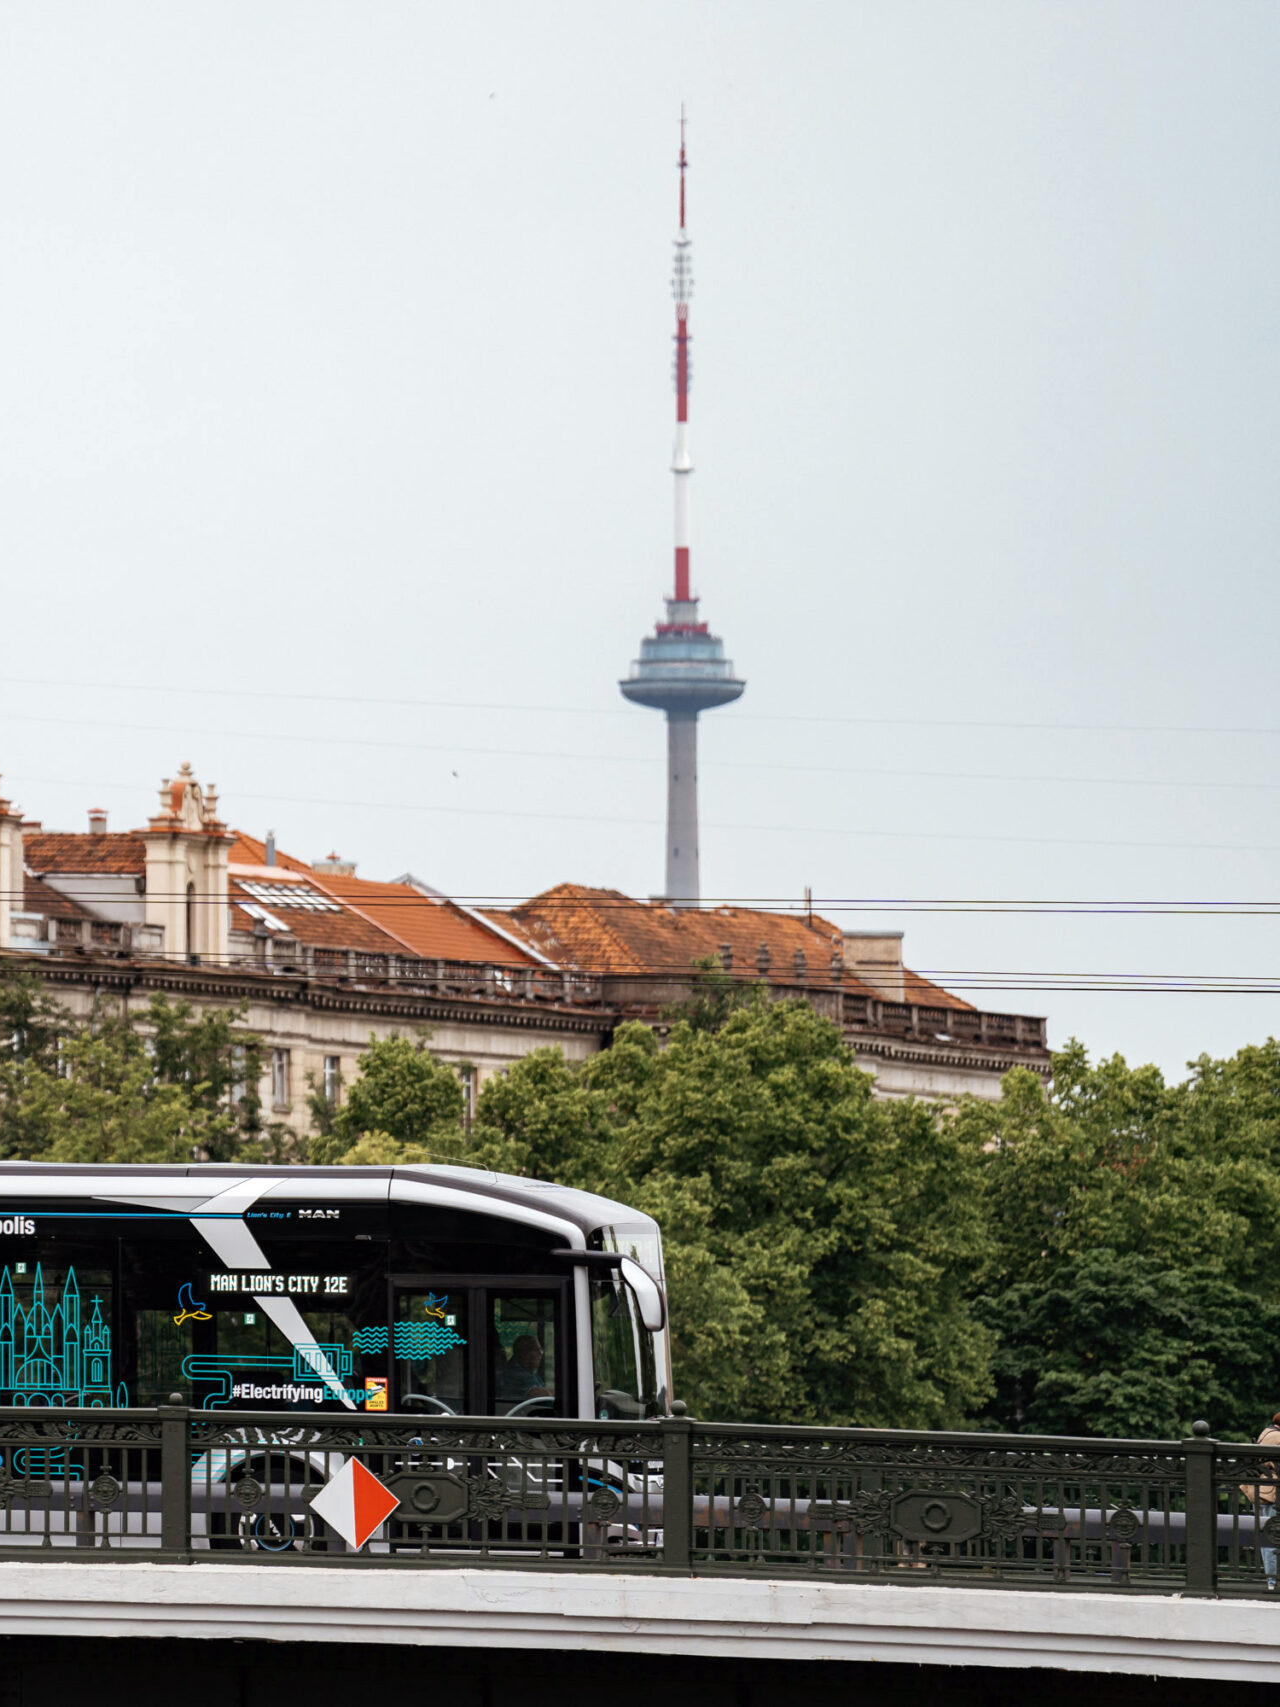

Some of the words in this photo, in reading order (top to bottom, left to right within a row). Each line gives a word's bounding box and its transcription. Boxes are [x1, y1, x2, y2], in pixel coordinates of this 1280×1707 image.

[298, 1209, 340, 1219] MAN
[210, 1274, 238, 1291] MAN
[241, 1275, 284, 1292] LION'S
[288, 1275, 319, 1292] CITY
[323, 1276, 348, 1293] 12E
